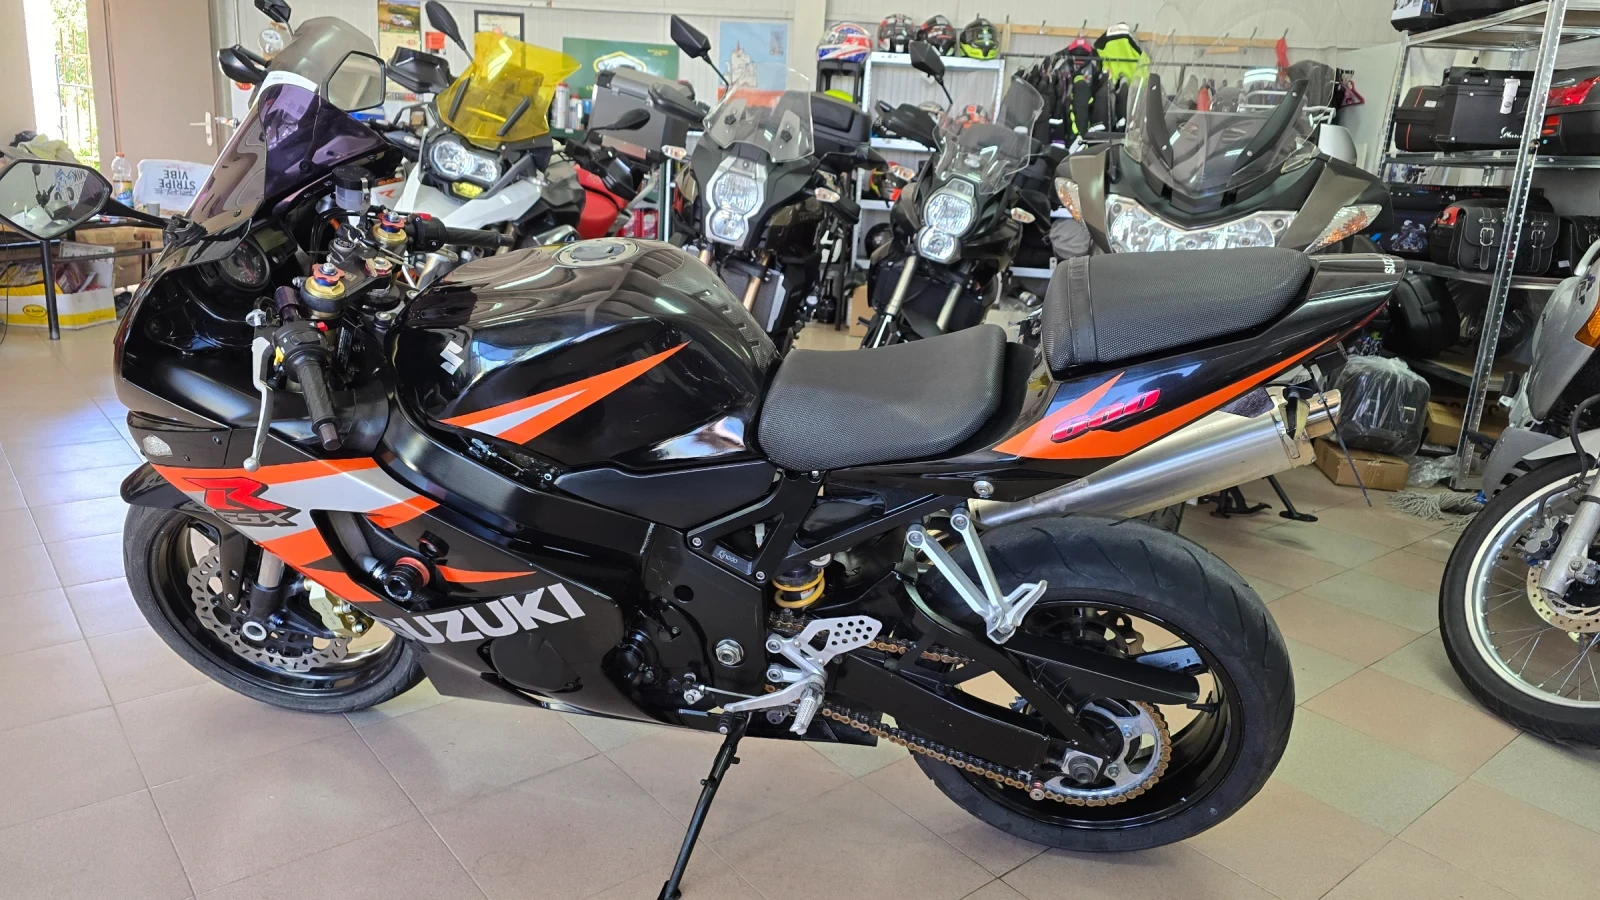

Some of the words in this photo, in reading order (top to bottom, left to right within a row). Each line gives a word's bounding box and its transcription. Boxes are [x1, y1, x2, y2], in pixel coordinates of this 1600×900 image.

[163, 169, 189, 180] VIBE
[158, 178, 196, 190] STRIPE
[1050, 388, 1161, 443] 600
